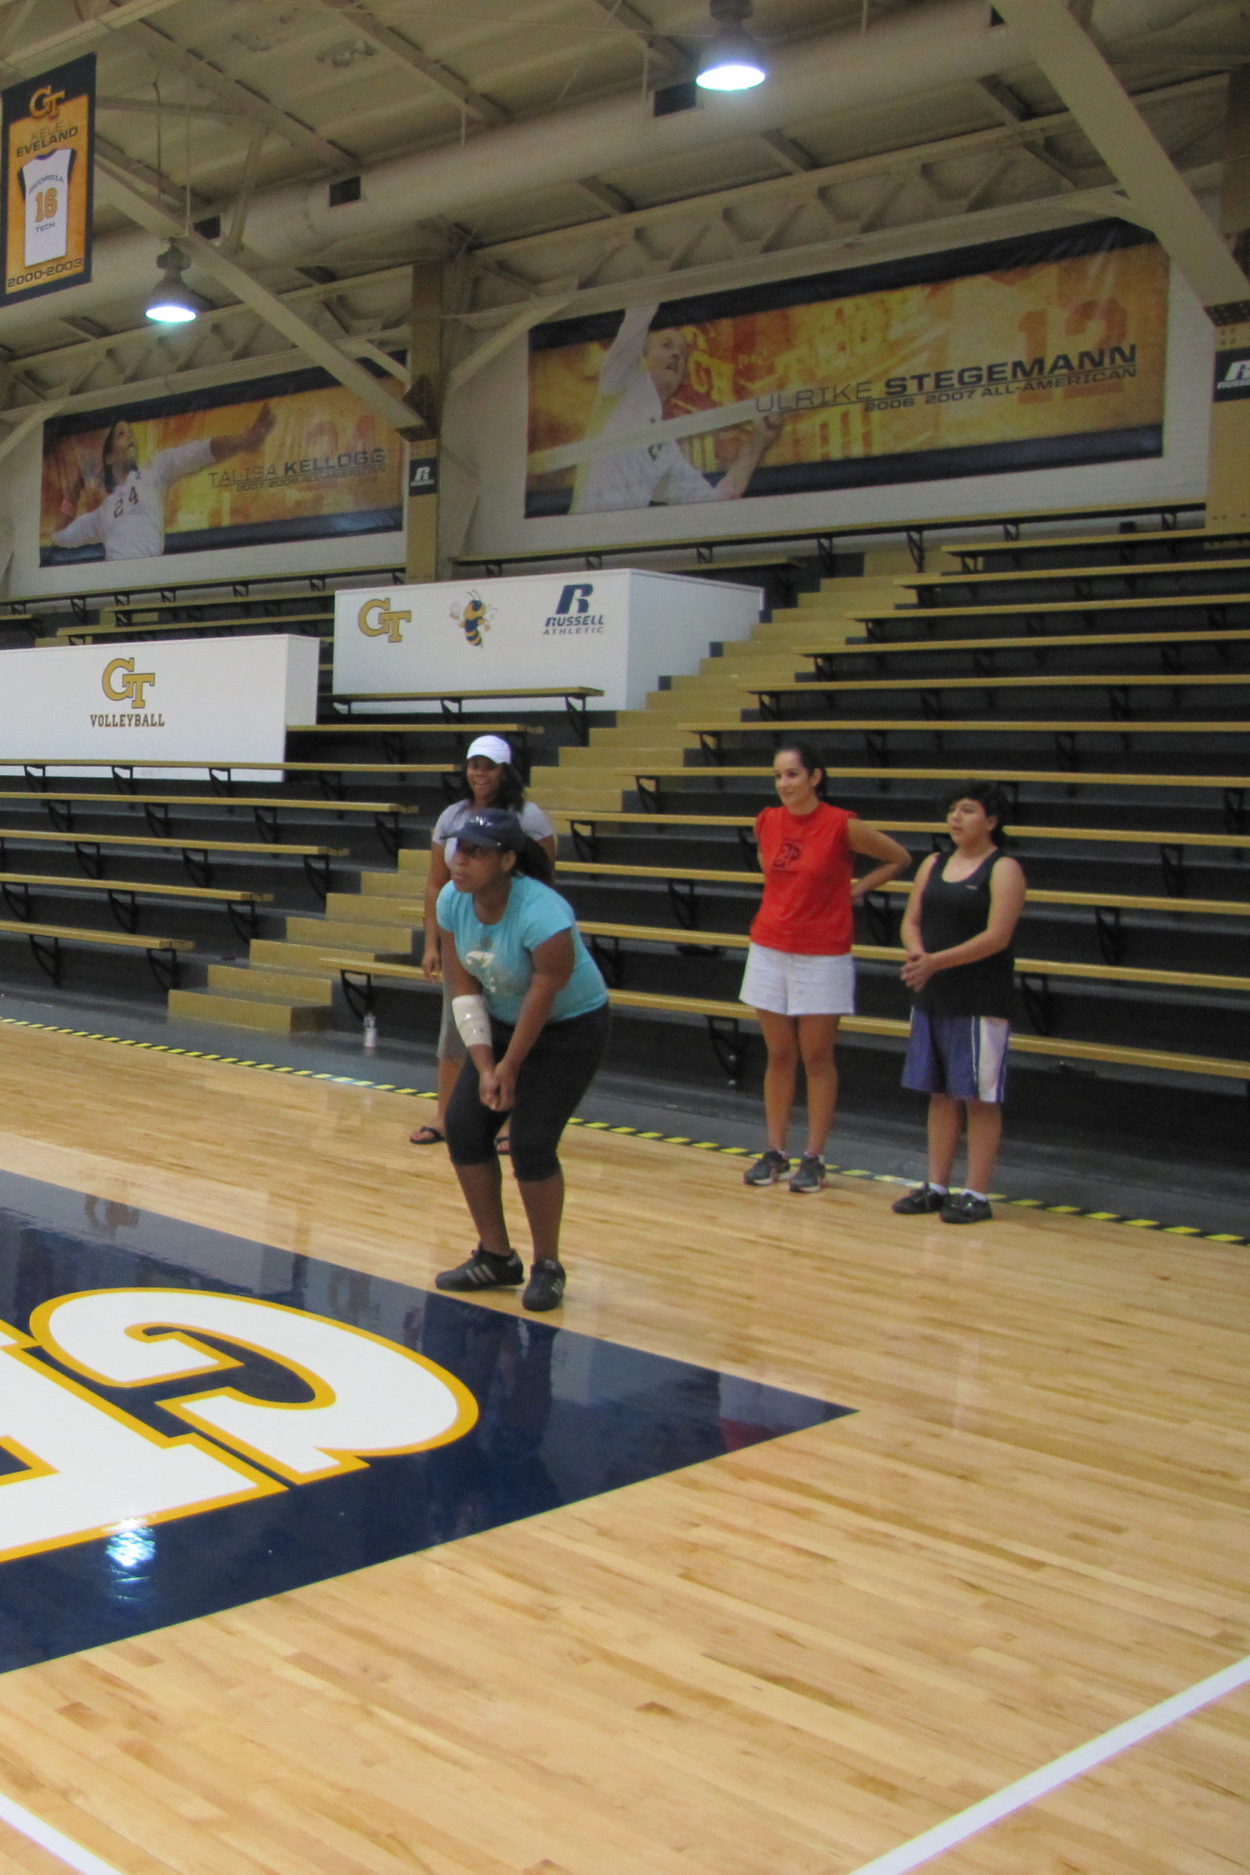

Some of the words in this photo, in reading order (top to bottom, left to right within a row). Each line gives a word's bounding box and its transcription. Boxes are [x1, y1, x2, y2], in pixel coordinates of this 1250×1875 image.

[29, 85, 66, 118] GT
[16, 126, 78, 157] EVELAND
[35, 187, 58, 223] 16
[35, 222, 56, 233] TECH
[7, 258, 82, 288] 2000-2003
[755, 381, 874, 413] ULRIKE
[885, 344, 1137, 396] STEGEMANN
[925, 390, 977, 405] 2007
[982, 367, 1137, 397] ALL-AMERICAN
[208, 462, 278, 488] TALISA
[284, 447, 387, 476] KELLOGG
[114, 486, 139, 519] 24
[358, 597, 412, 643] GT
[542, 626, 604, 636] ATHLETIC
[545, 615, 605, 628] RUSSELL
[102, 657, 156, 709] GT
[90, 713, 165, 728] VOLLEYBALL
